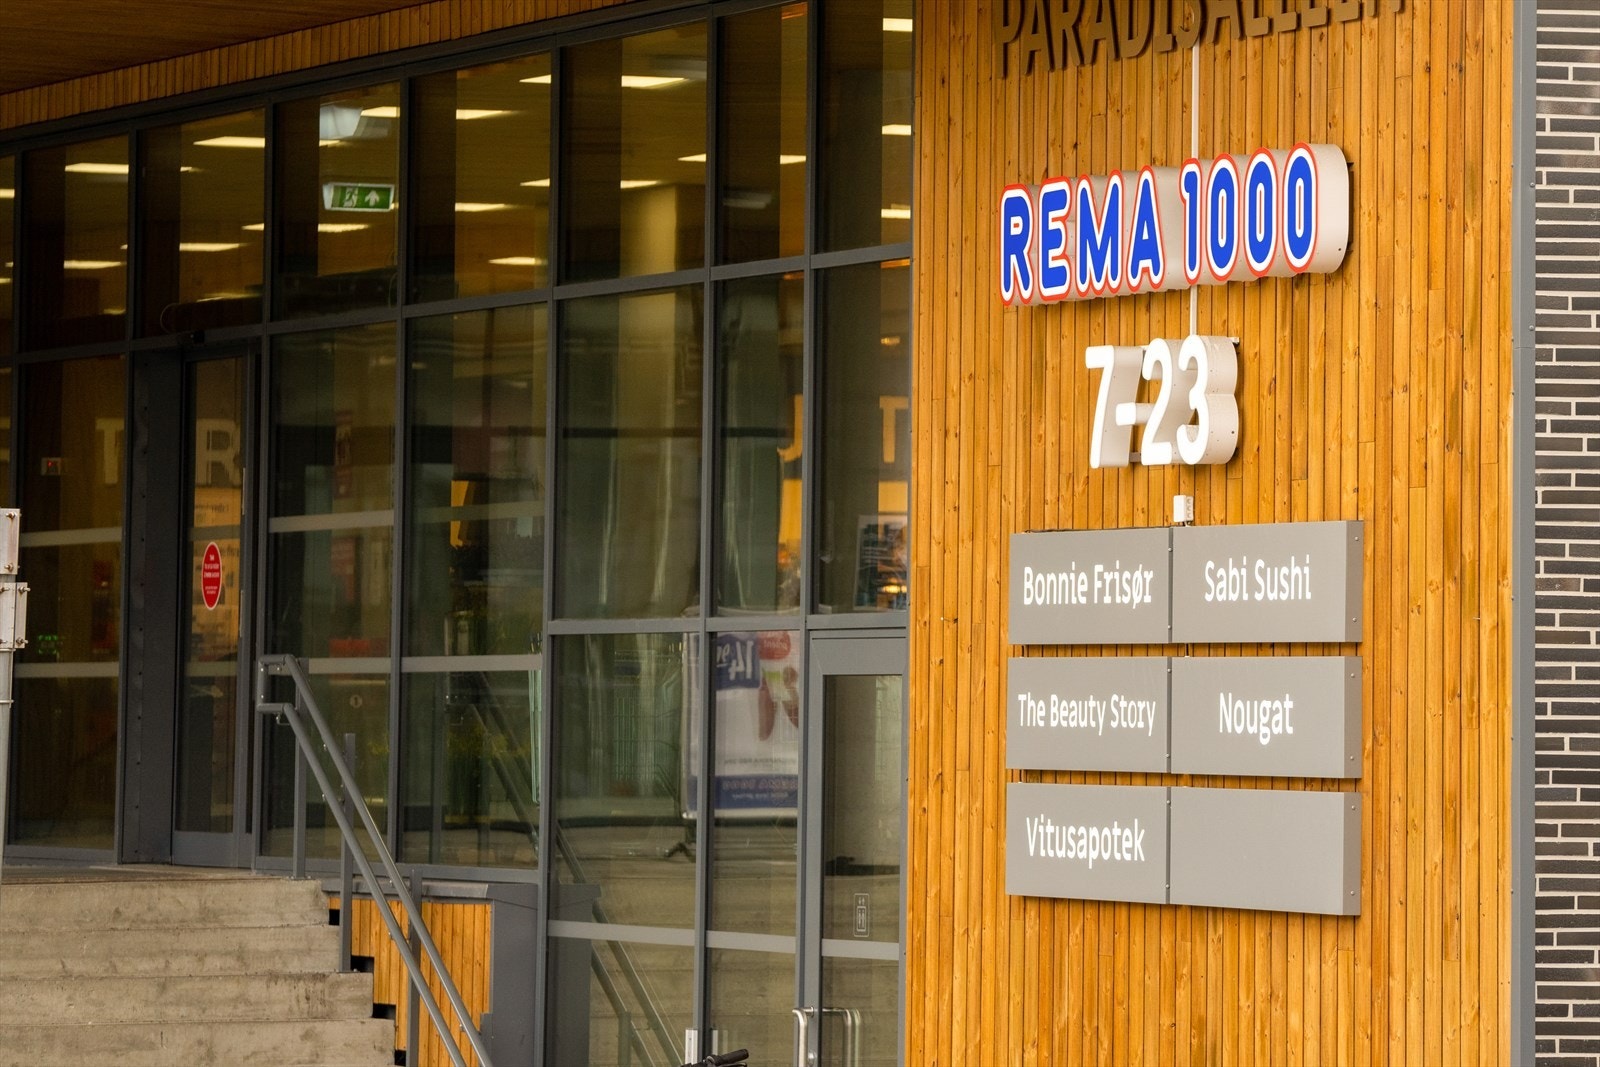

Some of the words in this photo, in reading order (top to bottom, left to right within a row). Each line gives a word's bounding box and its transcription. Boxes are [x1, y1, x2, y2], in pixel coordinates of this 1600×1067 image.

[1001, 164, 1166, 306] REMA
[1180, 141, 1319, 284] 1000
[1085, 334, 1210, 469] 7-23
[1023, 562, 1088, 606] Bonnie
[1094, 560, 1154, 609] Frisør
[1204, 556, 1249, 602] Sabi
[1254, 554, 1312, 601] Sushi
[1018, 693, 1046, 727] The
[1050, 694, 1106, 736] Beauty
[1110, 693, 1156, 737] Story
[1219, 692, 1294, 745] Nougat
[1026, 814, 1146, 869] Vitusapotek
